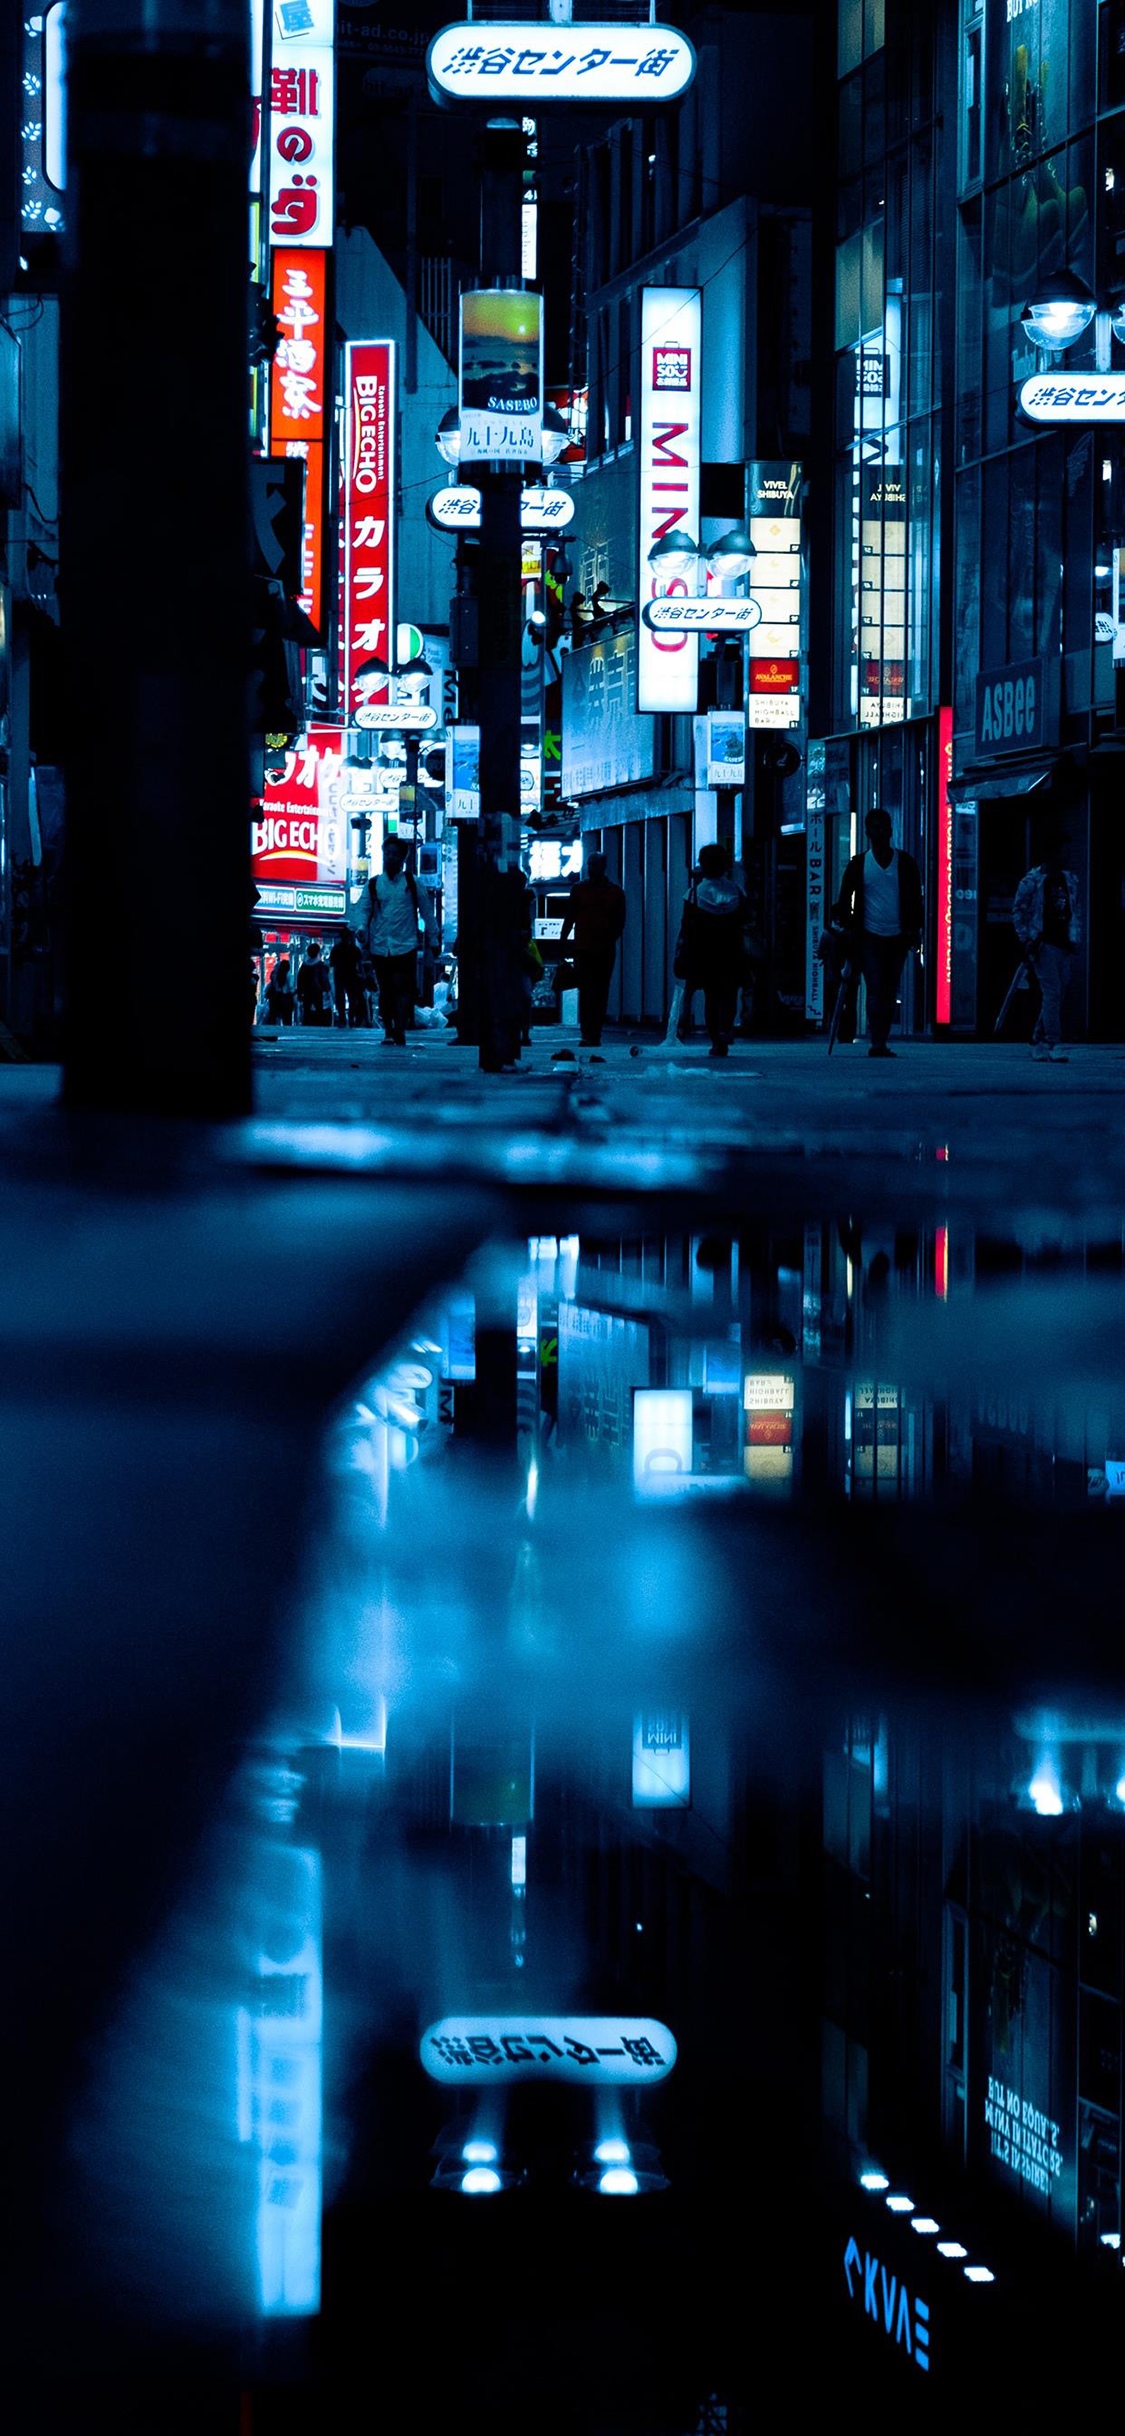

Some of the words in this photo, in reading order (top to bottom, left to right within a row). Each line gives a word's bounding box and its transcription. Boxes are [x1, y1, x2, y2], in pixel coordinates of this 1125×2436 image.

[441, 46, 680, 77] 渋谷センター街
[356, 375, 378, 423] BIG
[378, 385, 386, 418] Karaoke
[488, 396, 538, 411] SASEBO
[1029, 387, 1125, 406] 渋谷セン
[378, 420, 386, 480] Entertainment
[467, 426, 534, 448] 九十九島
[356, 425, 378, 493] ECHO
[757, 489, 795, 499] SHIBUYA
[763, 480, 788, 490] VIVEL
[654, 606, 754, 620] 渋谷センター街
[981, 675, 1036, 742] ASBee
[251, 817, 288, 856] BIG
[810, 858, 821, 896] BAR
